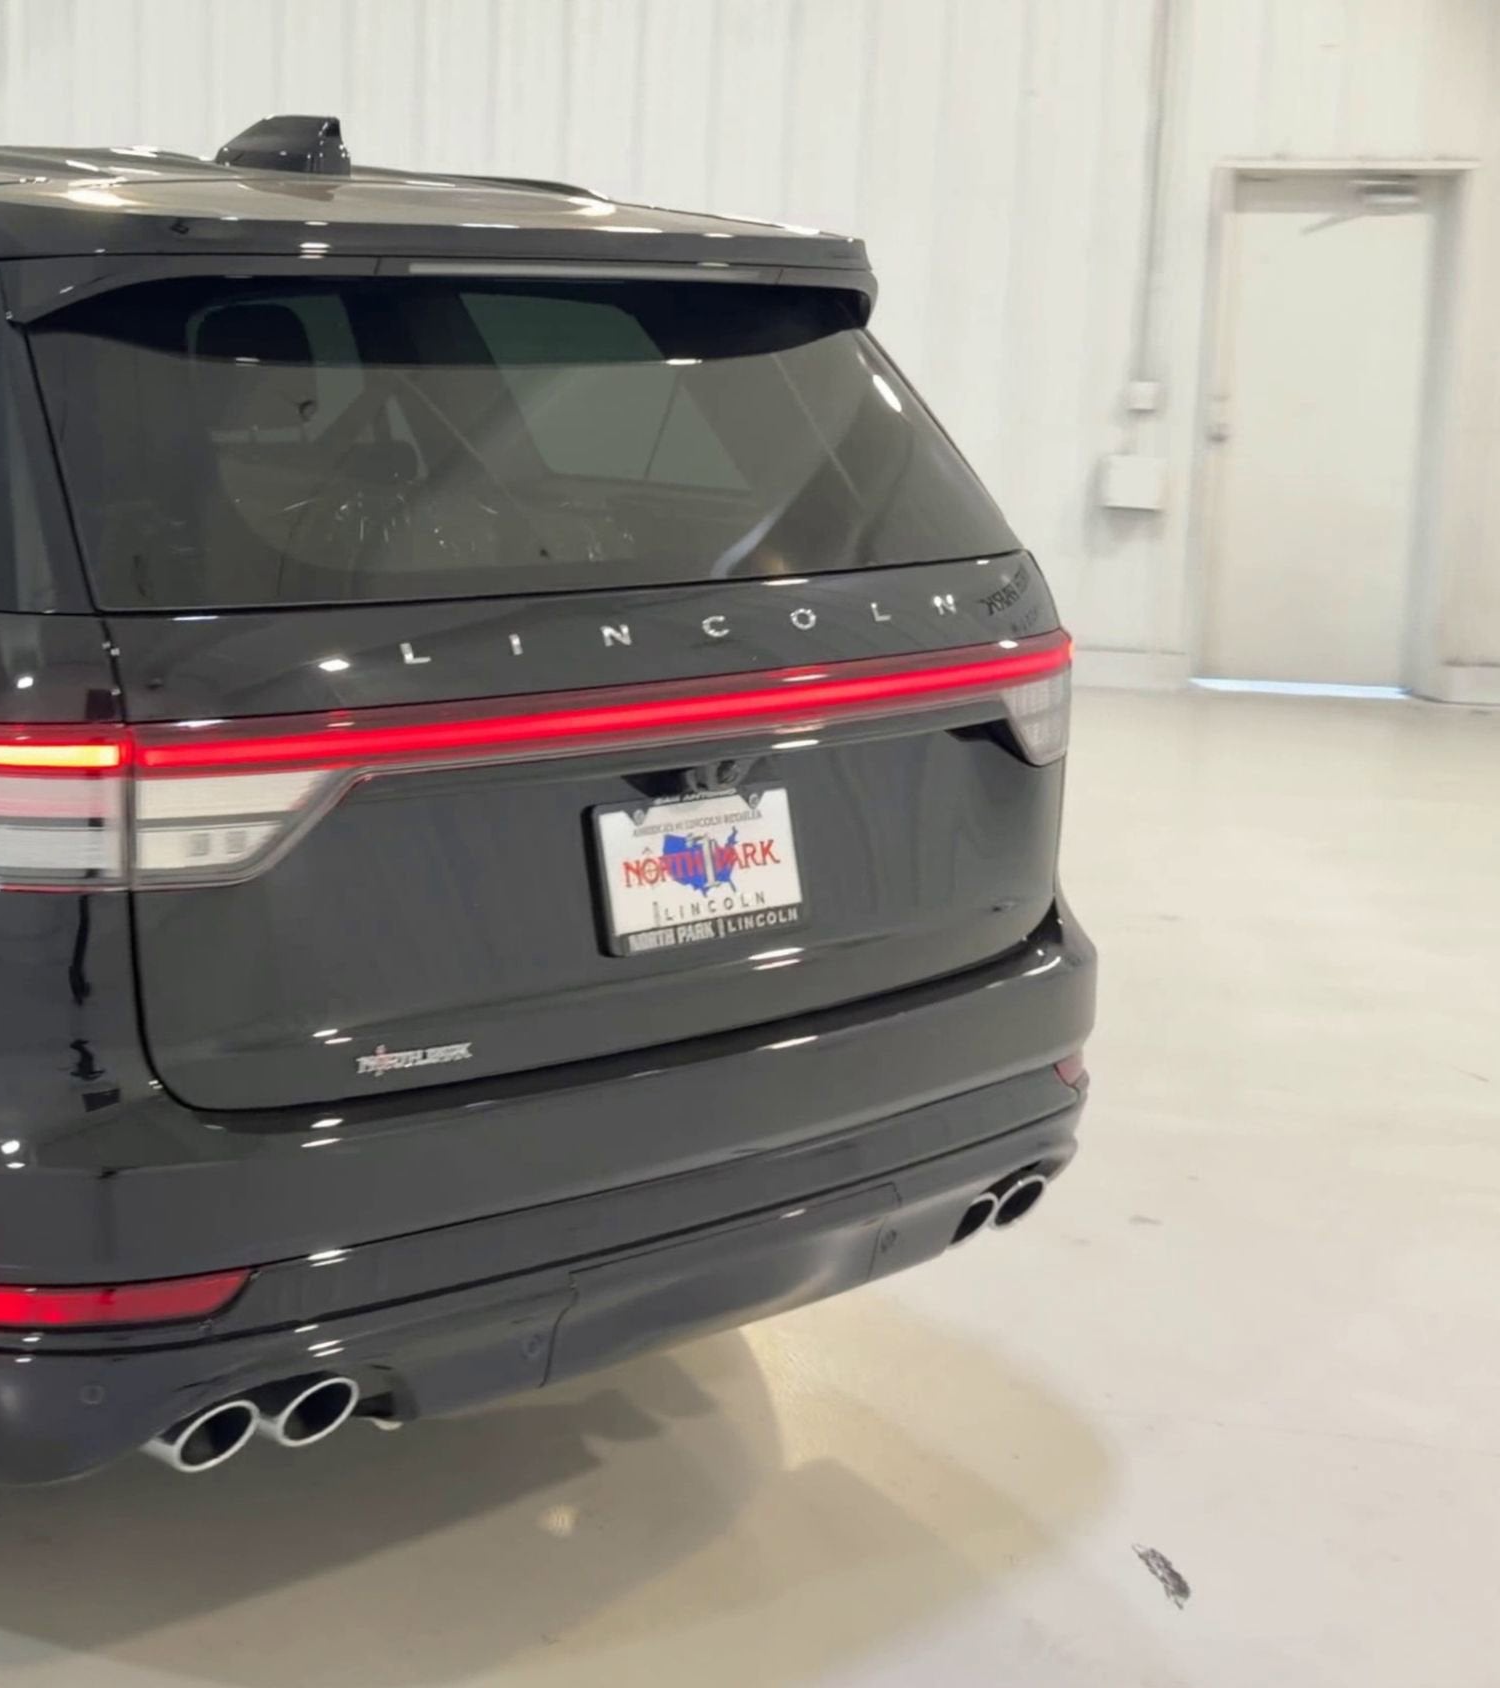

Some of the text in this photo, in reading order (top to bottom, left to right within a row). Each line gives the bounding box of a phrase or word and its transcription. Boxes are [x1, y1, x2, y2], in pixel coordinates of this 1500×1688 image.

[401, 594, 958, 666] LINCOLN
[622, 838, 781, 888] NORTH PARK
[628, 907, 798, 952] NORTH PARK LINCOLN
[663, 891, 766, 922] LINCOLN
